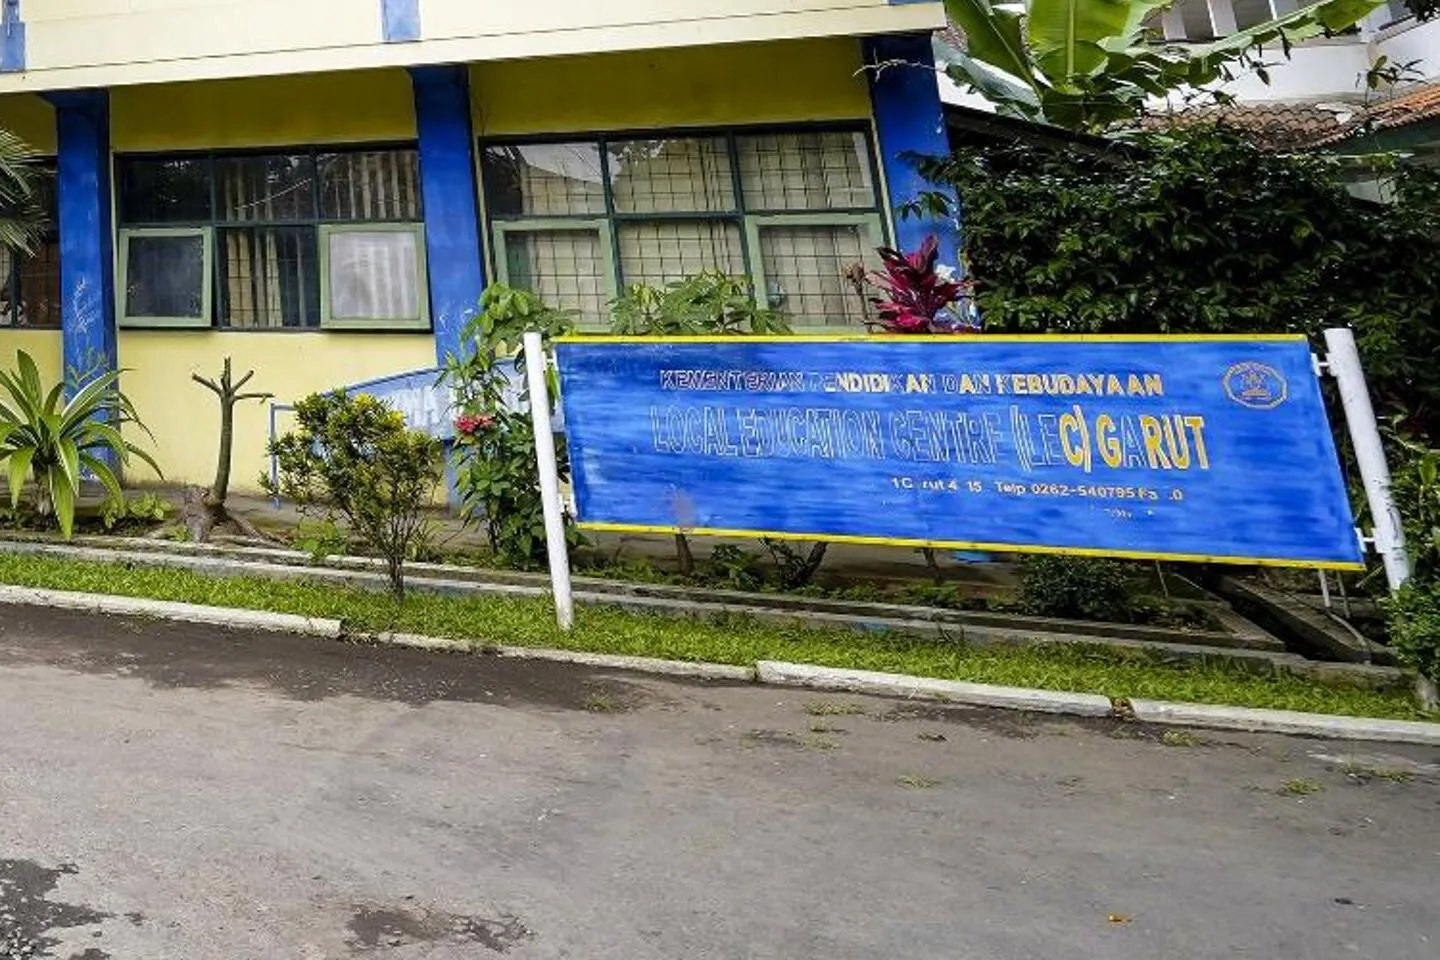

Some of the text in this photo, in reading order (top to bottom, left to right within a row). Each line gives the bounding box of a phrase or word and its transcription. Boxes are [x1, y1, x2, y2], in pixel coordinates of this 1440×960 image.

[994, 373, 1164, 397] KEBUDAYAAN
[649, 404, 738, 456] LOCAL
[737, 406, 885, 462] EDUCATION
[1095, 411, 1210, 470] GARUT
